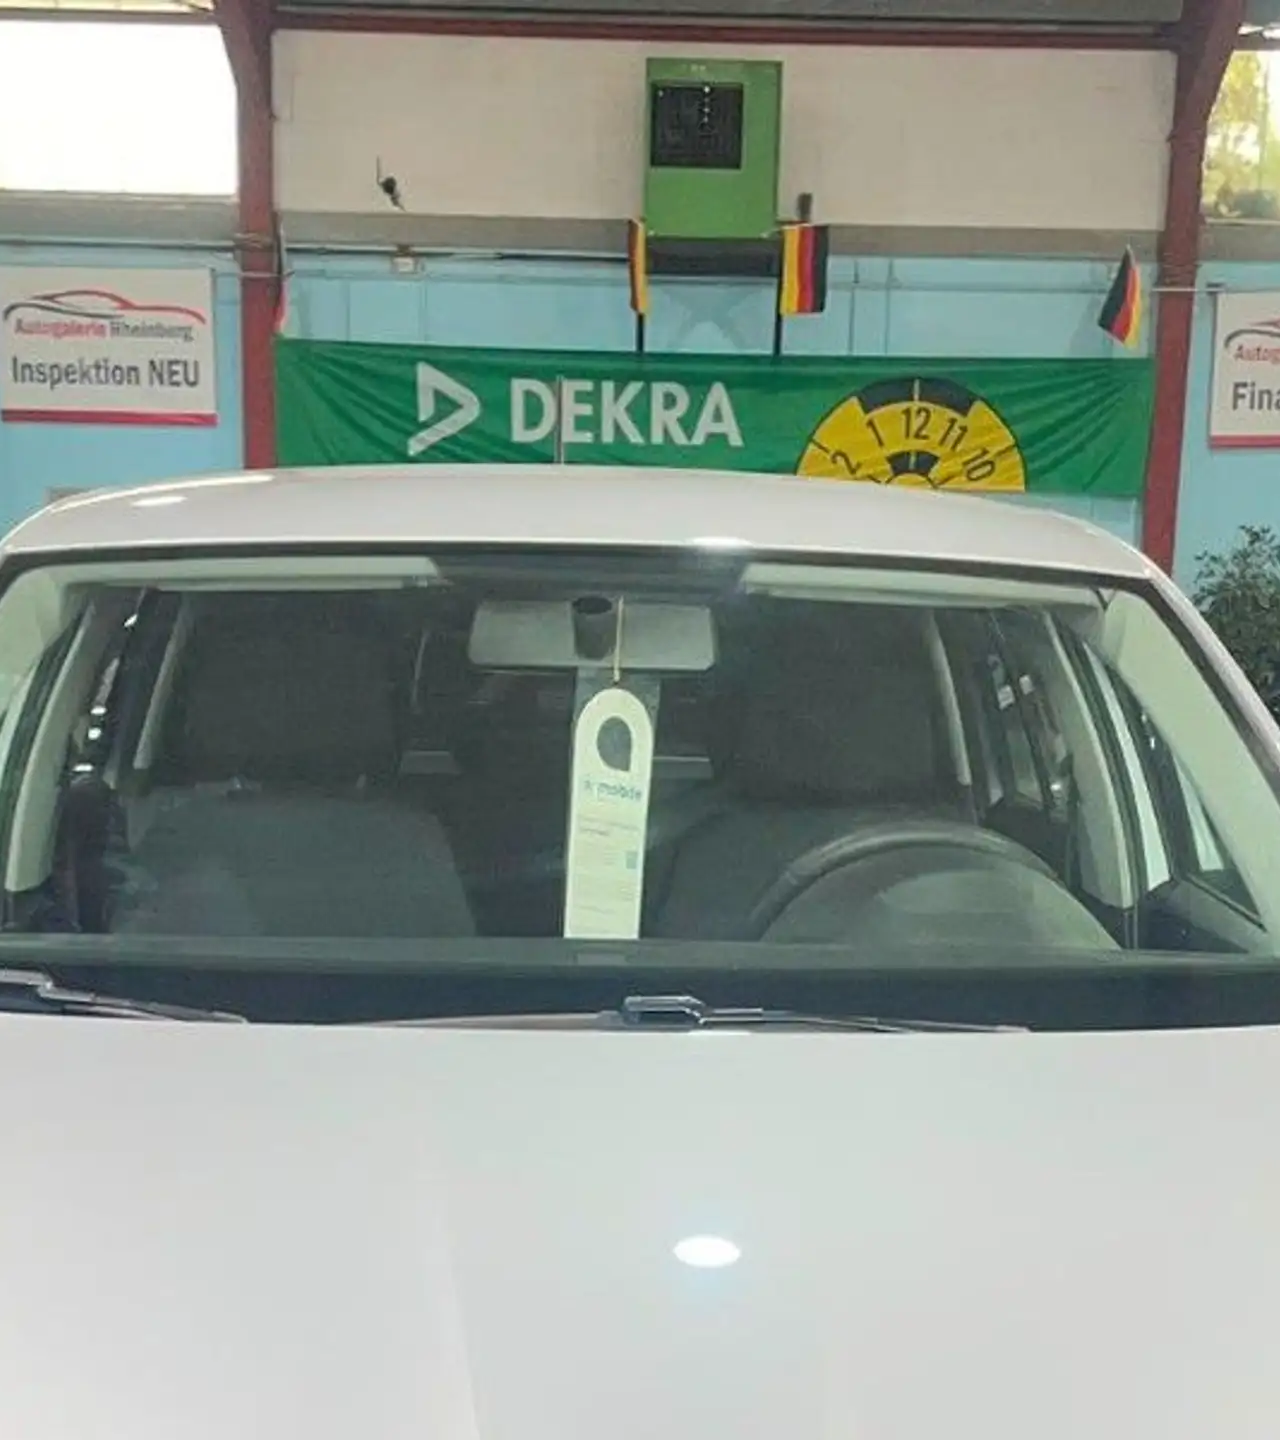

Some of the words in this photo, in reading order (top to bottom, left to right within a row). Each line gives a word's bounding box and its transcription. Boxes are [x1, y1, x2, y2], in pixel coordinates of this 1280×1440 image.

[11, 355, 141, 390] Inspektion
[148, 358, 200, 388] NEU
[509, 377, 745, 447] DEKRA
[900, 406, 933, 441] 12
[938, 416, 968, 451] 11
[961, 446, 996, 482] 10
